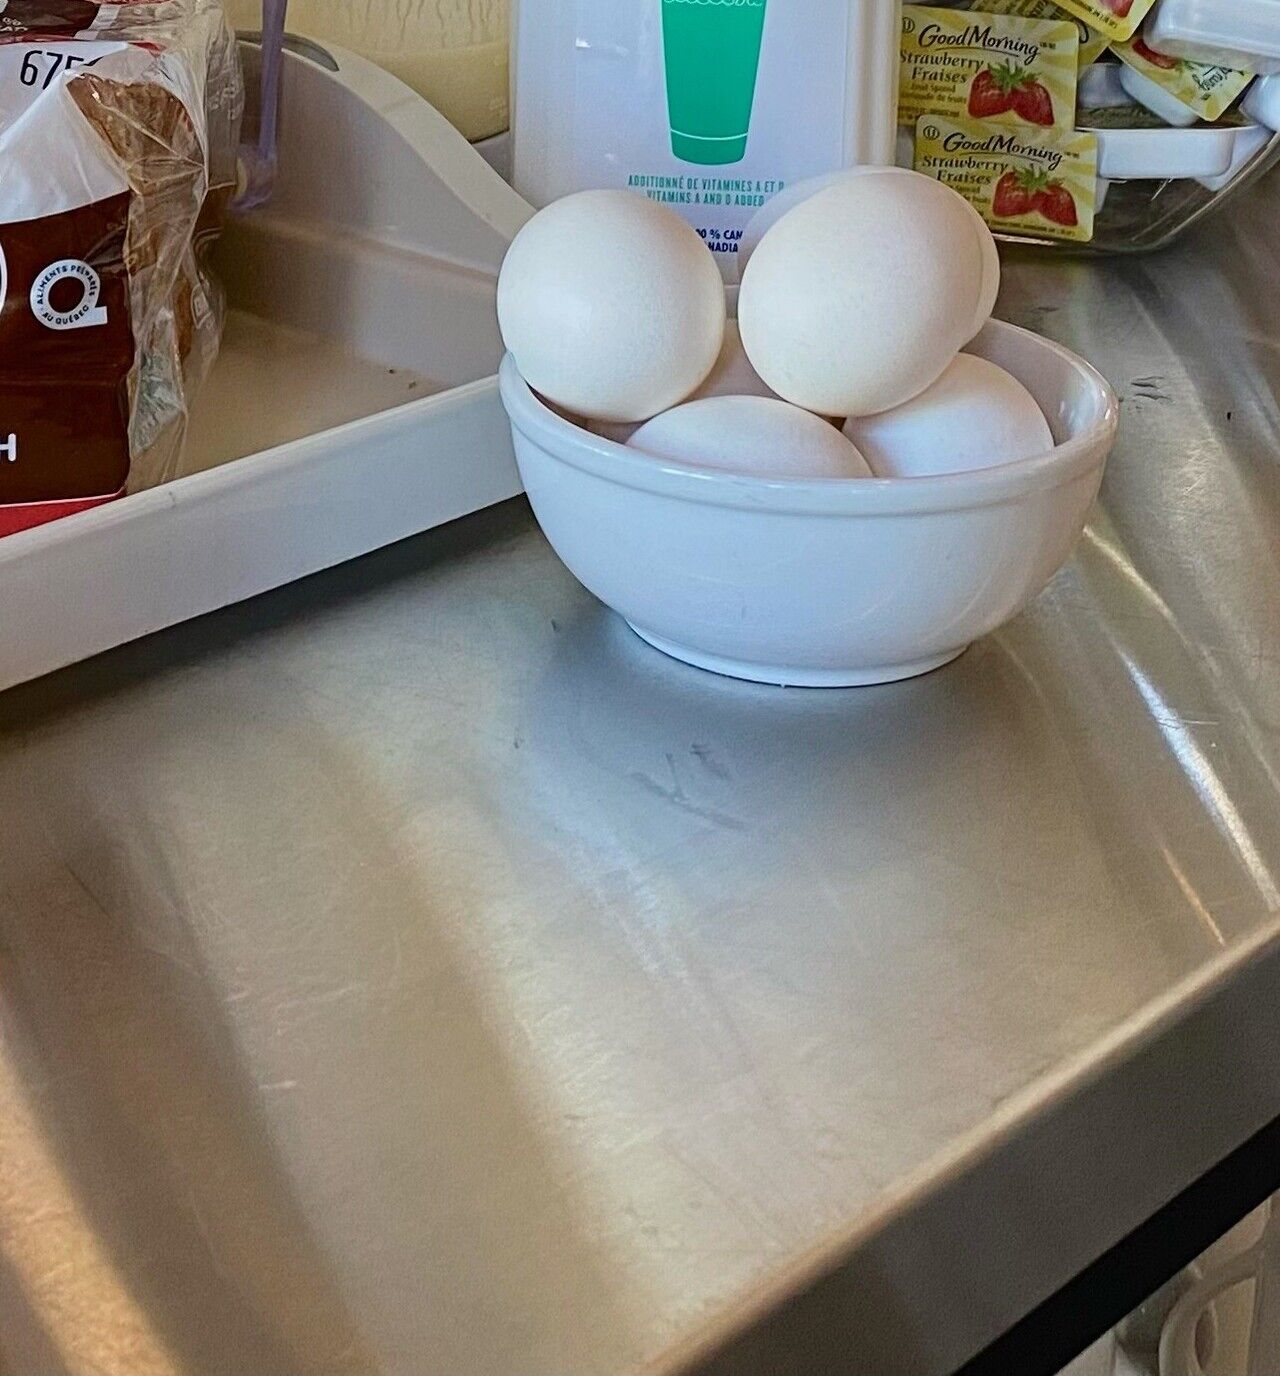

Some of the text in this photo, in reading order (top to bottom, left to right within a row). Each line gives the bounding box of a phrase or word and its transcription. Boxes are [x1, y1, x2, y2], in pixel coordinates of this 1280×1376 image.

[900, 49, 984, 74] Strawberry
[911, 66, 967, 84] Fraises
[922, 155, 1009, 174] Strawberry
[628, 174, 684, 191] ADDITIONNÉ
[687, 179, 698, 190] DE
[702, 178, 753, 193] VITAMINES
[755, 180, 761, 192] A
[764, 181, 776, 192] ET
[936, 170, 992, 186] Fraises
[646, 190, 691, 205] VITAMINS
[694, 192, 701, 204] A
[703, 192, 722, 205] AND
[734, 194, 765, 208] ADDED
[707, 241, 738, 253] NADIA
